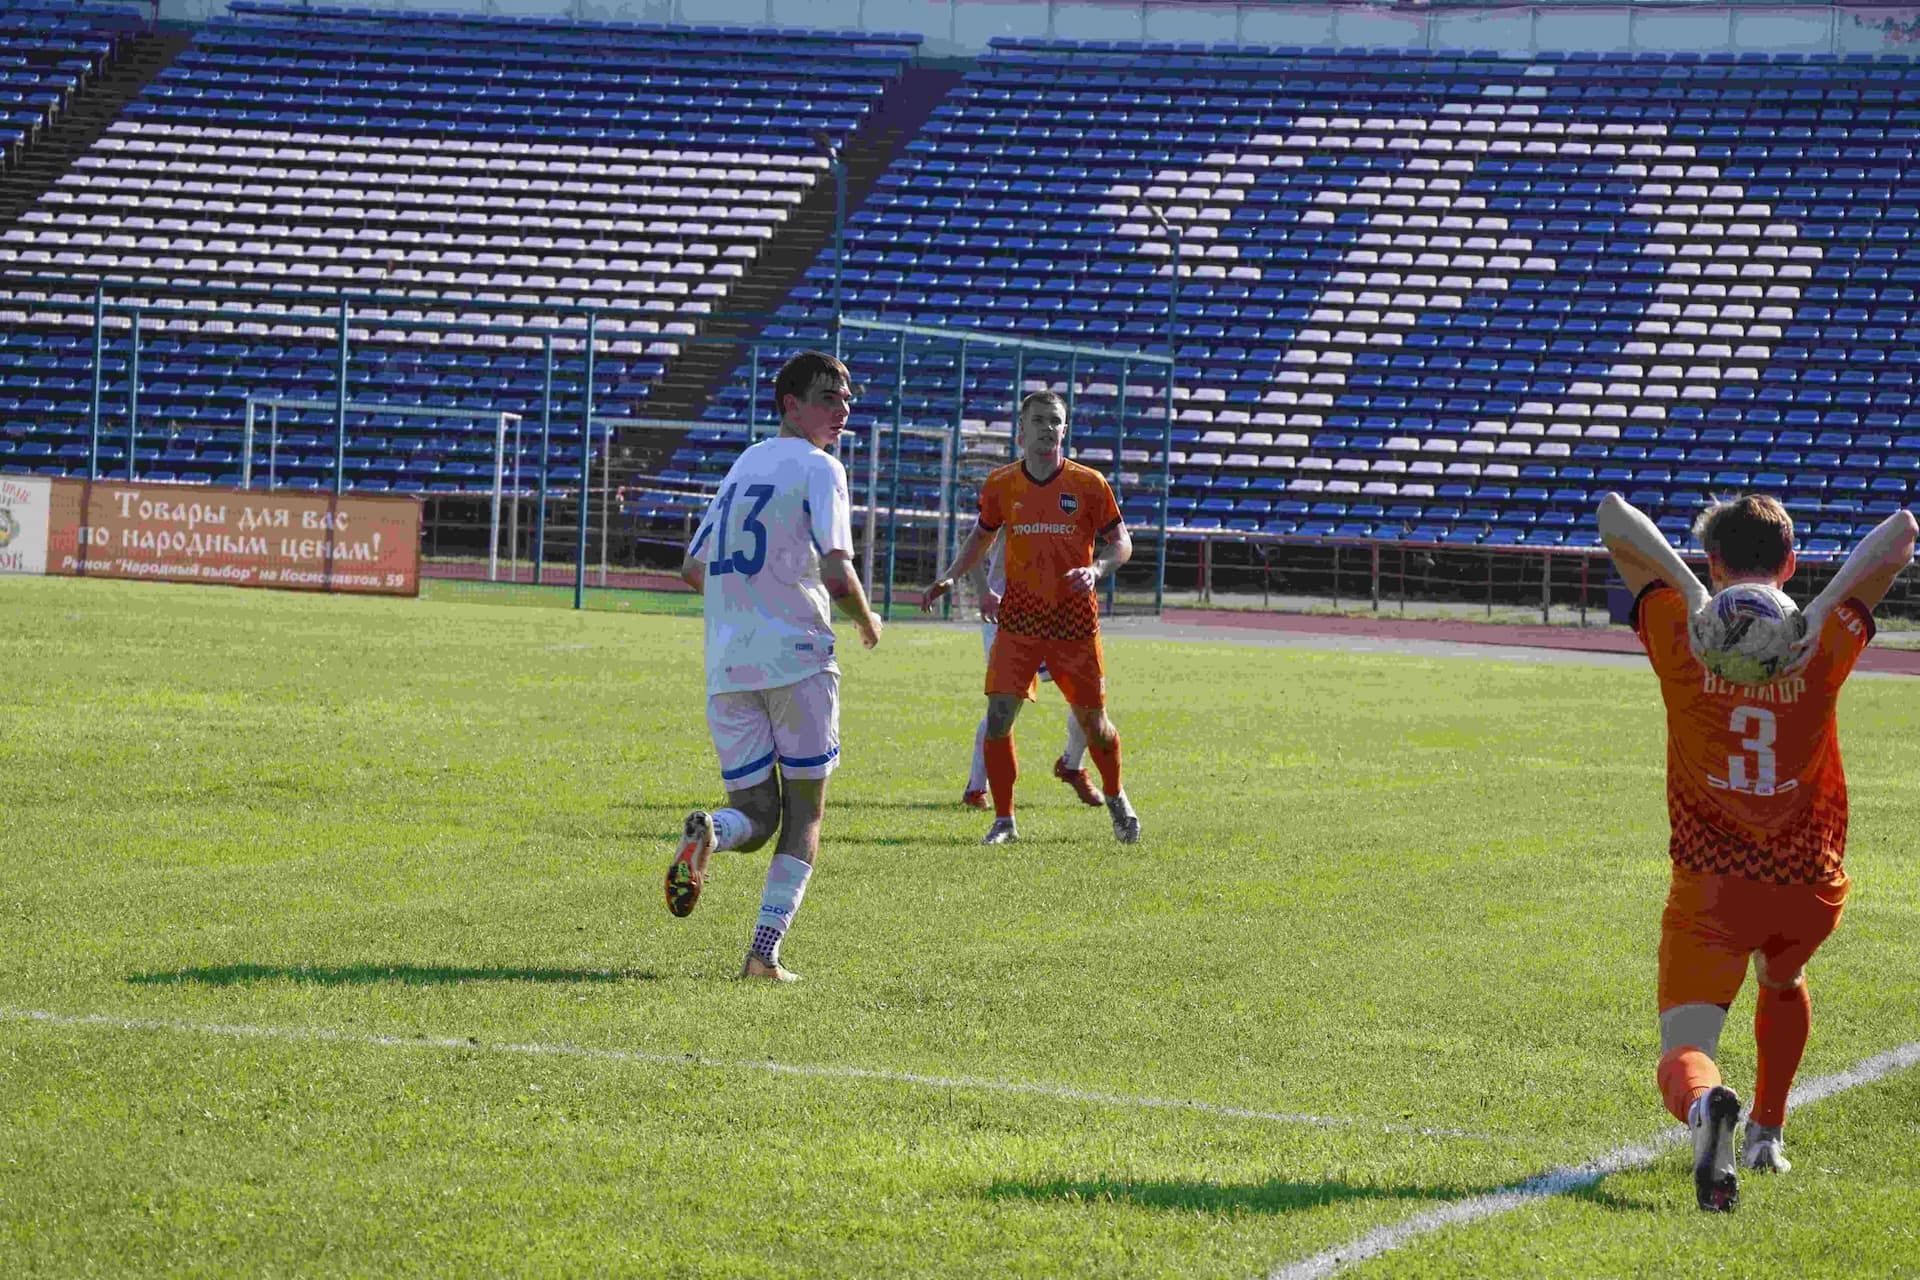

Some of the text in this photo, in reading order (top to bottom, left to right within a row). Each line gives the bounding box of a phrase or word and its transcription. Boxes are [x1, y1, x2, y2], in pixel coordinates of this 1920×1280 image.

[114, 491, 349, 531] Товары для вас
[710, 483, 776, 577] 13
[78, 526, 381, 562] по народным ценам!
[62, 555, 112, 572] Рынок
[116, 558, 199, 577] "Народный
[202, 564, 257, 581] выбор"
[259, 569, 278, 581] на
[386, 573, 405, 587] 59
[1728, 705, 1777, 796] 3
